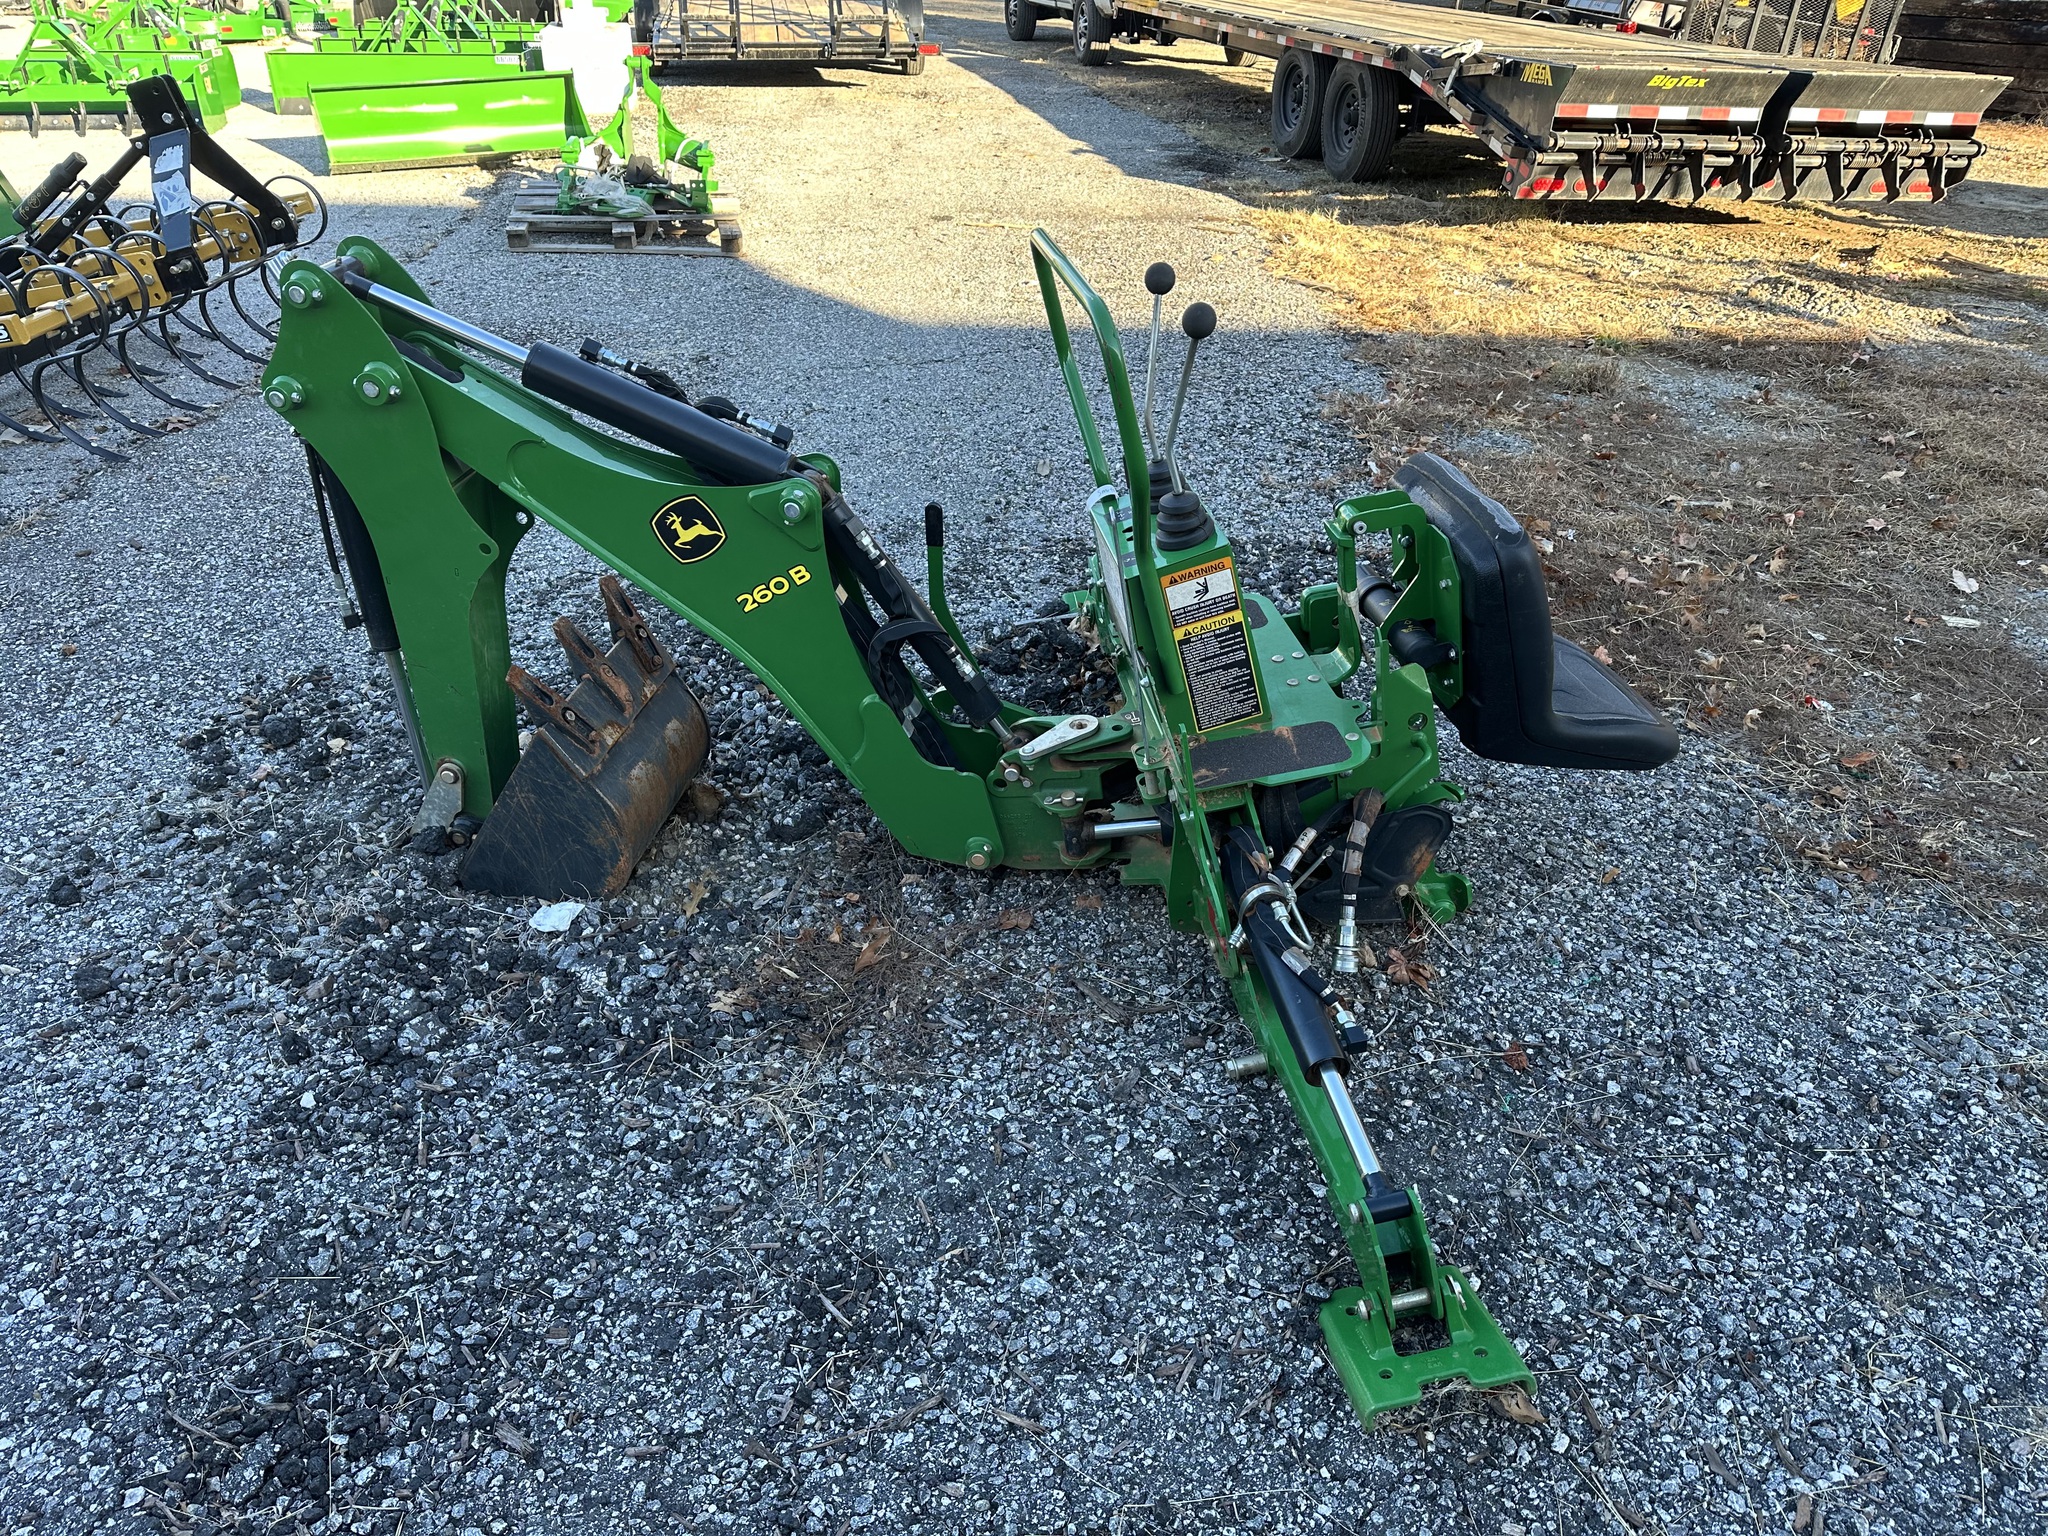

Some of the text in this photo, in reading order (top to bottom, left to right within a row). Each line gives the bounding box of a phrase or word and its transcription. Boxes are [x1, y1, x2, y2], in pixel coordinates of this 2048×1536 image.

[1520, 63, 1553, 86] MEGA
[1647, 74, 1709, 90] BigTex
[1177, 561, 1226, 582] WARNING
[735, 564, 812, 614] 260 B
[1192, 615, 1236, 635] CAUTION
